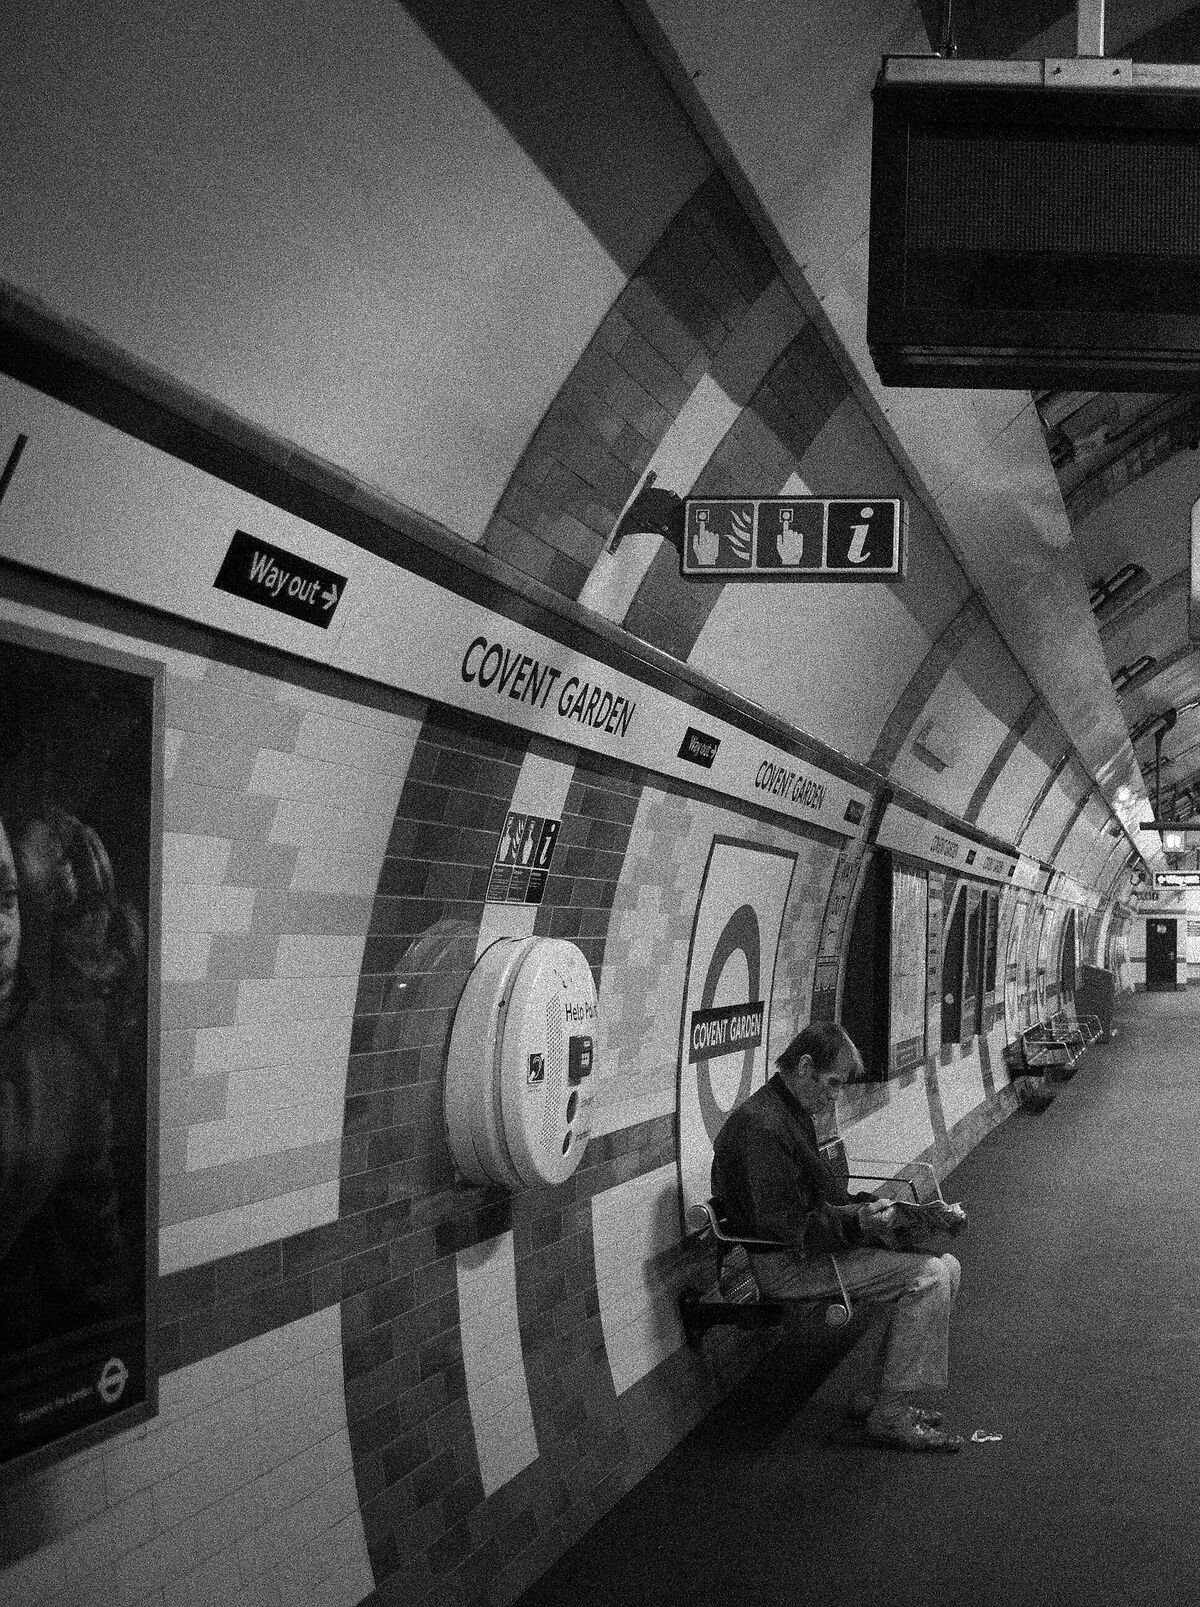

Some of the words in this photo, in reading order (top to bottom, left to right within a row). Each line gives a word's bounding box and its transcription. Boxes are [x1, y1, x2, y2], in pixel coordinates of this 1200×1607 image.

[249, 551, 290, 597] Way
[288, 576, 321, 605] out
[461, 636, 562, 709] COVENT
[557, 676, 637, 738] GARDEN
[754, 760, 796, 798] COVENT
[791, 775, 827, 811] GARDEN
[565, 1003, 584, 1024] Help
[693, 1018, 728, 1050] COVENT
[730, 1012, 761, 1041] GARDEN
